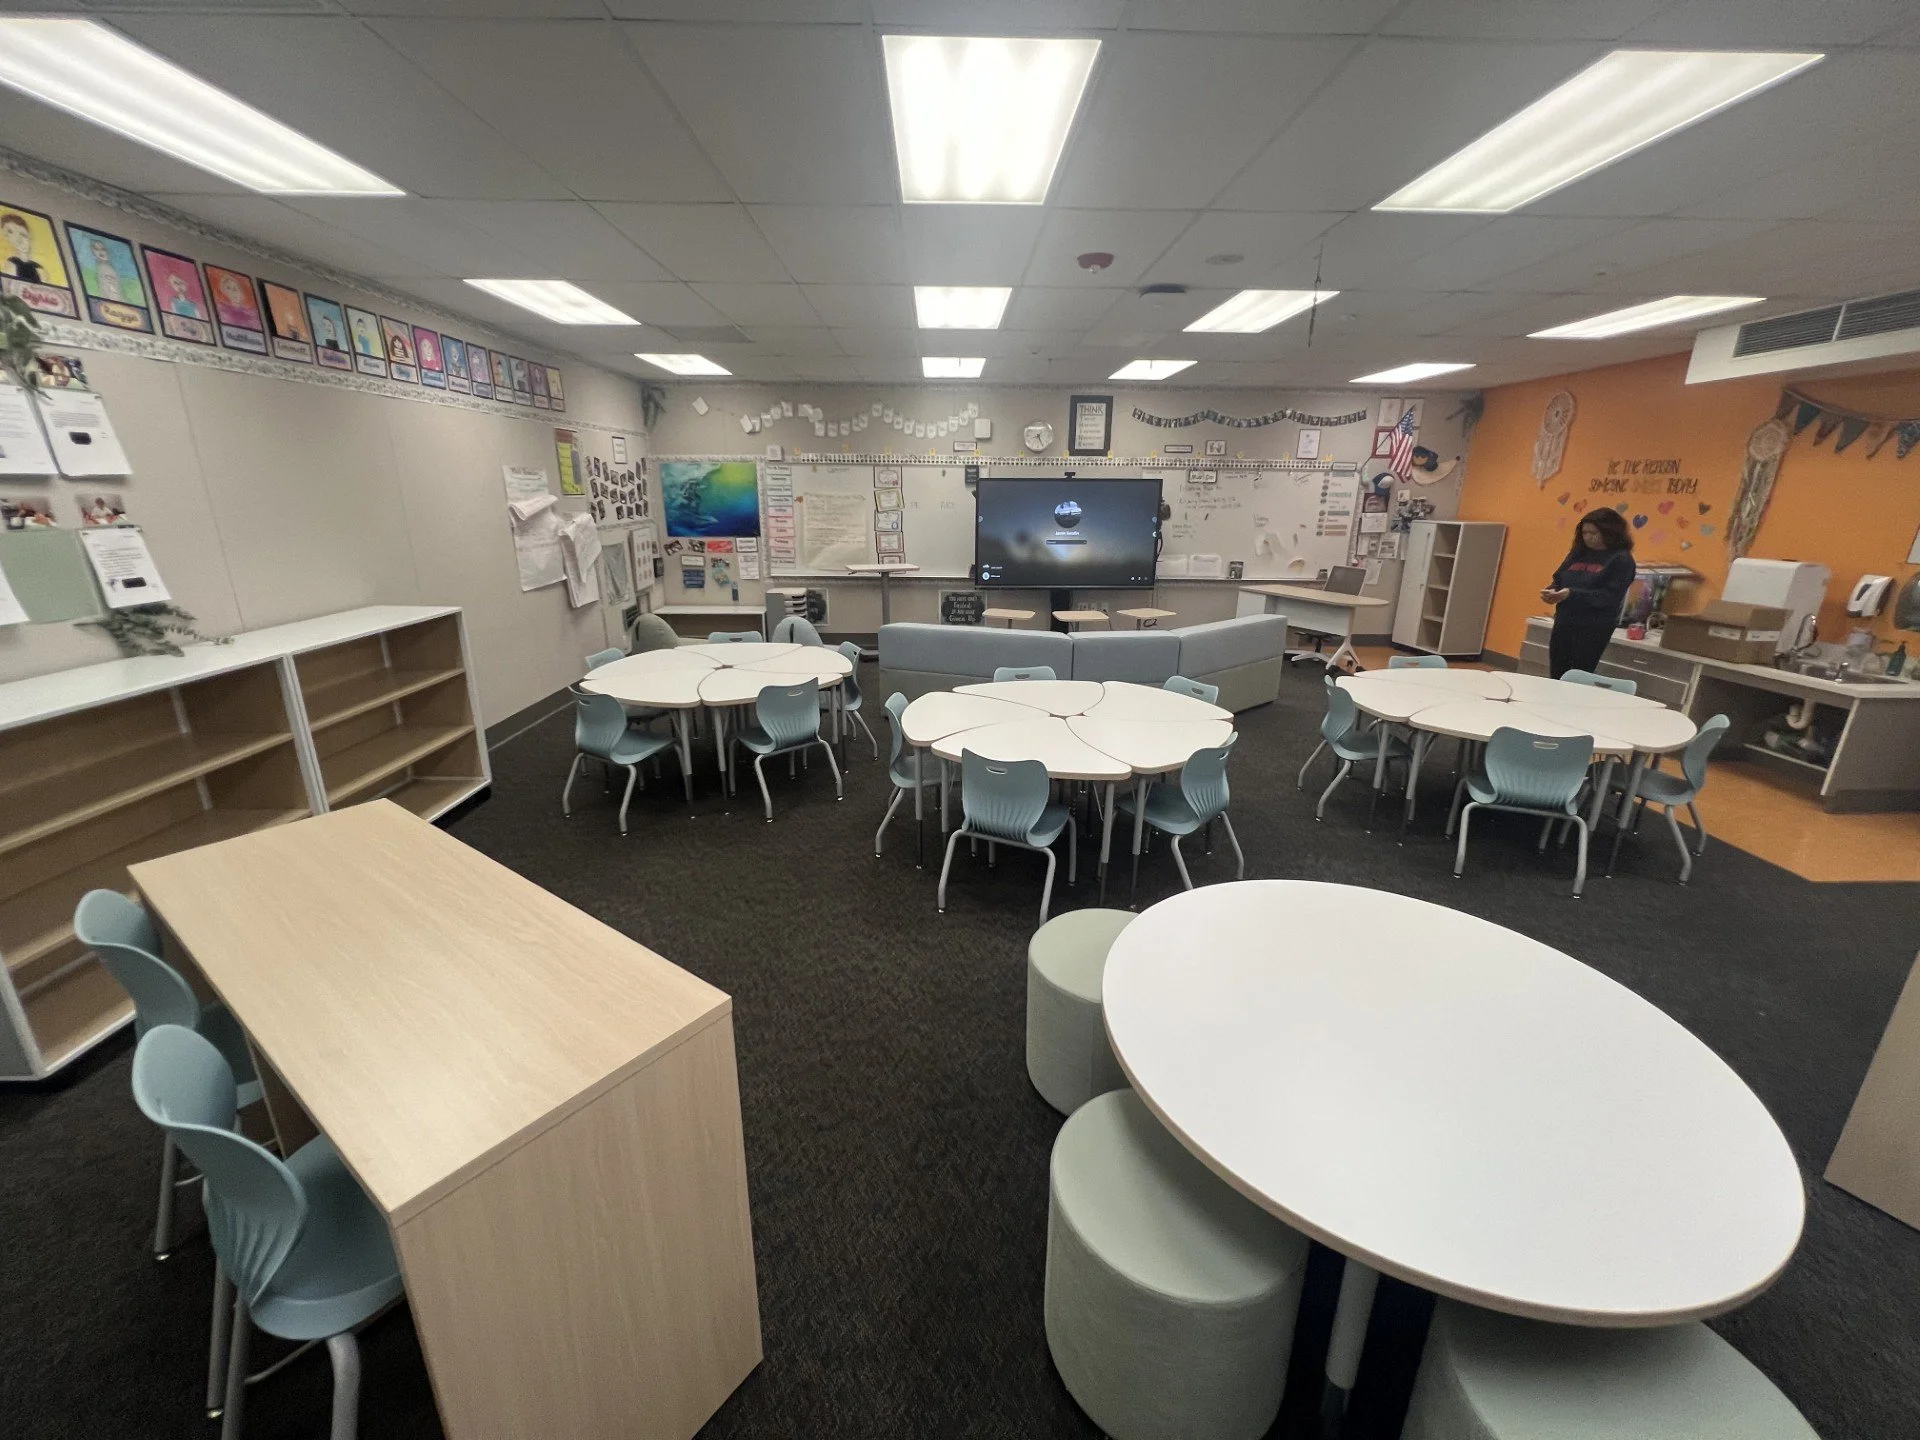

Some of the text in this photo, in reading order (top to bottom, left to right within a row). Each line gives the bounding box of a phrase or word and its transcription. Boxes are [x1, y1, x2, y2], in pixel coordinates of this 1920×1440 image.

[1080, 405, 1103, 414] THINK
[1623, 459, 1641, 475] THE
[1642, 459, 1681, 474] REASON
[1588, 478, 1629, 493] SOMEONE
[1667, 478, 1698, 494] TODAY
